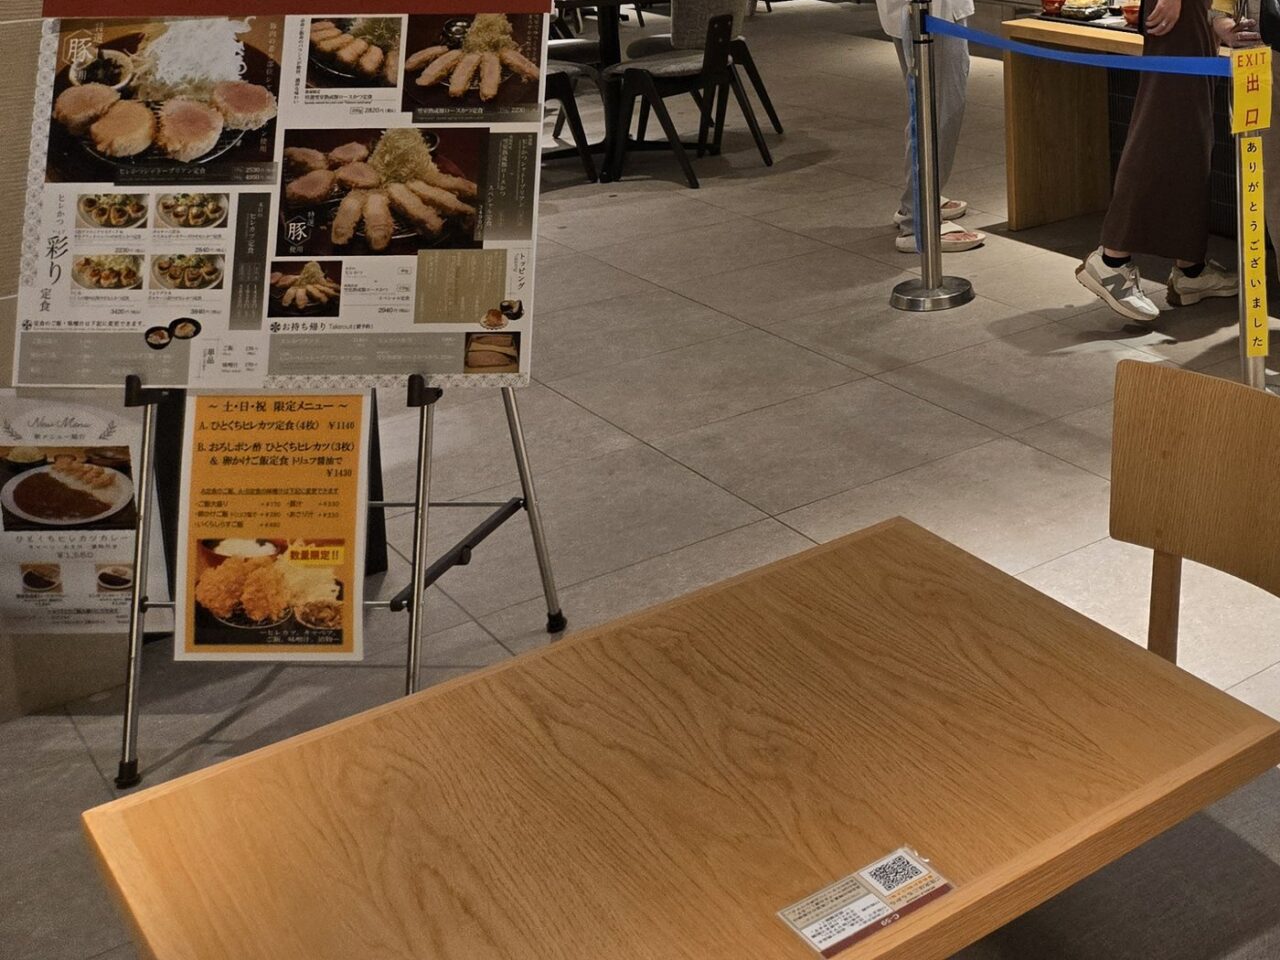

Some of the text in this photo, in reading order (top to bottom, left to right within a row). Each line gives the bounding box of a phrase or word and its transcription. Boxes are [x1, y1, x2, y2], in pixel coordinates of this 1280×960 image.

[1237, 51, 1267, 68] EXIT
[288, 222, 306, 241] 豚
[1245, 141, 1264, 348] ありがとうございました
[45, 235, 69, 286] 彩り
[40, 288, 52, 312] 定食
[273, 400, 334, 413] 限定メニュー
